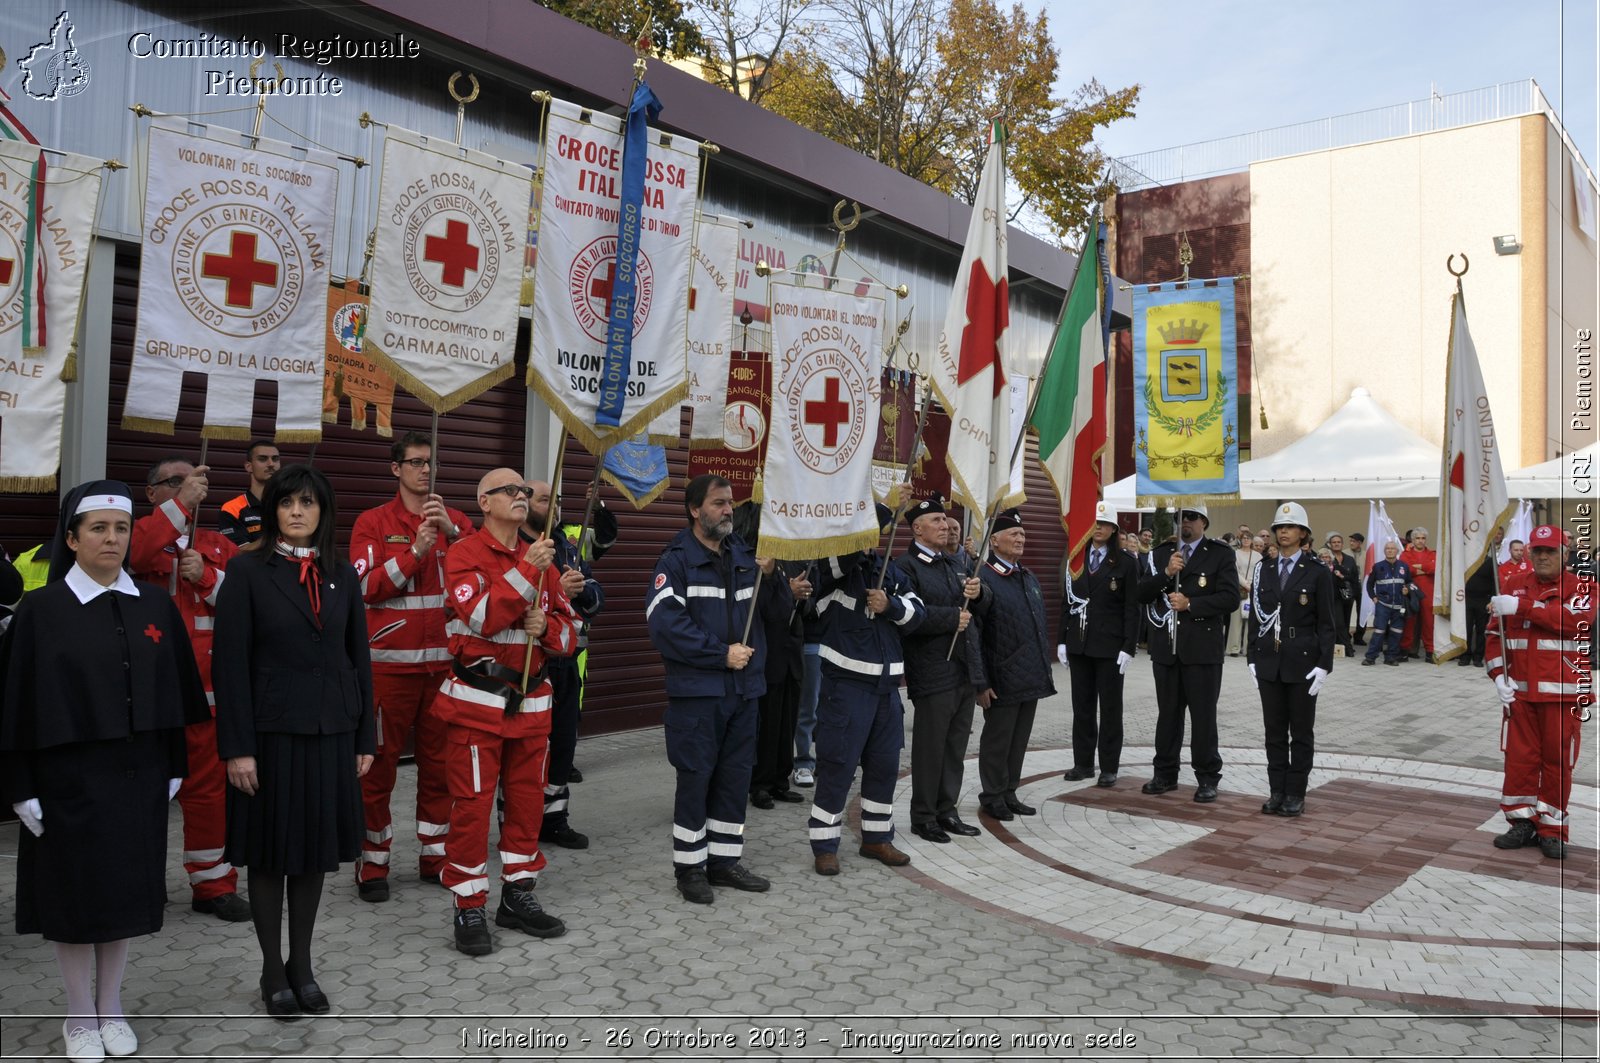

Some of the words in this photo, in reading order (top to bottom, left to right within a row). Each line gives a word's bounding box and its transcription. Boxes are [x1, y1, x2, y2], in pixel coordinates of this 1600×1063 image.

[178, 148, 236, 171] VOLONTARI
[242, 162, 261, 176] DEL
[266, 166, 312, 187] SOCCORSO
[557, 134, 620, 171] CROCE
[201, 214, 217, 230] DI
[223, 208, 284, 240] GINEVRA
[392, 179, 428, 227] CROCE
[430, 172, 476, 194] ROSSA
[479, 188, 516, 254] ITALIANA
[421, 206, 432, 218] DI
[433, 196, 478, 219] GINEVRA
[150, 188, 199, 245] CROCE
[201, 179, 269, 201] ROSSA
[274, 192, 325, 272] ITALIANA
[478, 218, 491, 235] 22
[649, 218, 657, 231] DI
[281, 242, 296, 261] 22
[406, 216, 437, 301] CONVENZIONE
[619, 203, 637, 283] SOCCORSO
[176, 229, 224, 326] CONVENZIONE
[481, 239, 497, 289] AGOSTO
[279, 262, 300, 313] AGOSTO
[571, 256, 597, 330] CONVENZIONE
[591, 246, 601, 261] DI
[252, 308, 281, 332] 1864
[615, 292, 630, 319] DEL
[385, 311, 488, 340] SOTTOCOMITATO
[493, 330, 505, 342] DI
[146, 340, 212, 364] GRUPPO
[217, 350, 232, 366] DI
[238, 353, 257, 369] LA
[262, 356, 316, 375] LOGGIA
[327, 353, 365, 369] SQUADRA
[383, 332, 500, 365] CARMAGNOLA
[602, 328, 625, 410] VOLONTARI
[802, 361, 812, 377] DI
[851, 379, 863, 396] 22
[691, 455, 727, 465] GRUPPO
[771, 500, 853, 518] CASTAGNOLE
